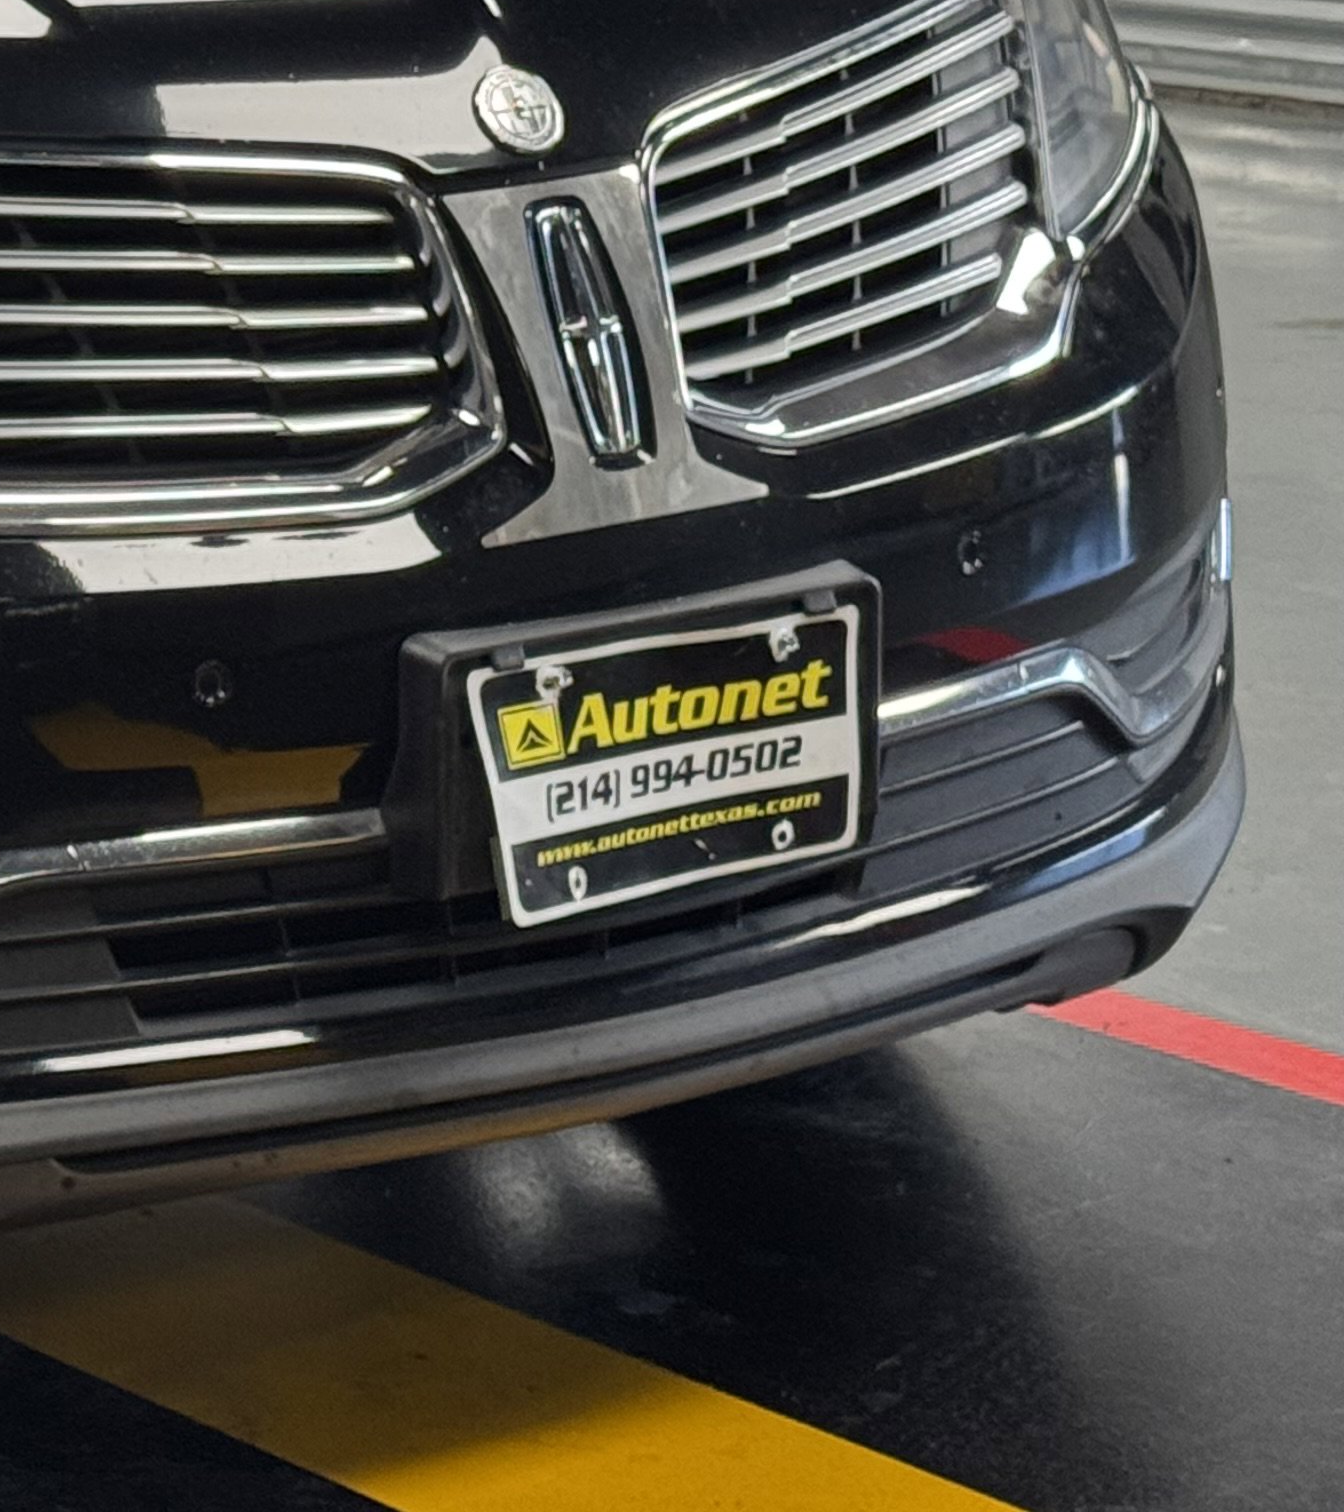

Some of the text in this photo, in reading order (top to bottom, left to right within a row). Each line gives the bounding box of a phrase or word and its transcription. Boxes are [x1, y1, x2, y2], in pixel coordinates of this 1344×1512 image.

[567, 659, 832, 755] Autonet
[546, 736, 802, 823] (214) 994-0502
[536, 791, 821, 867] www.autonettexas.com
